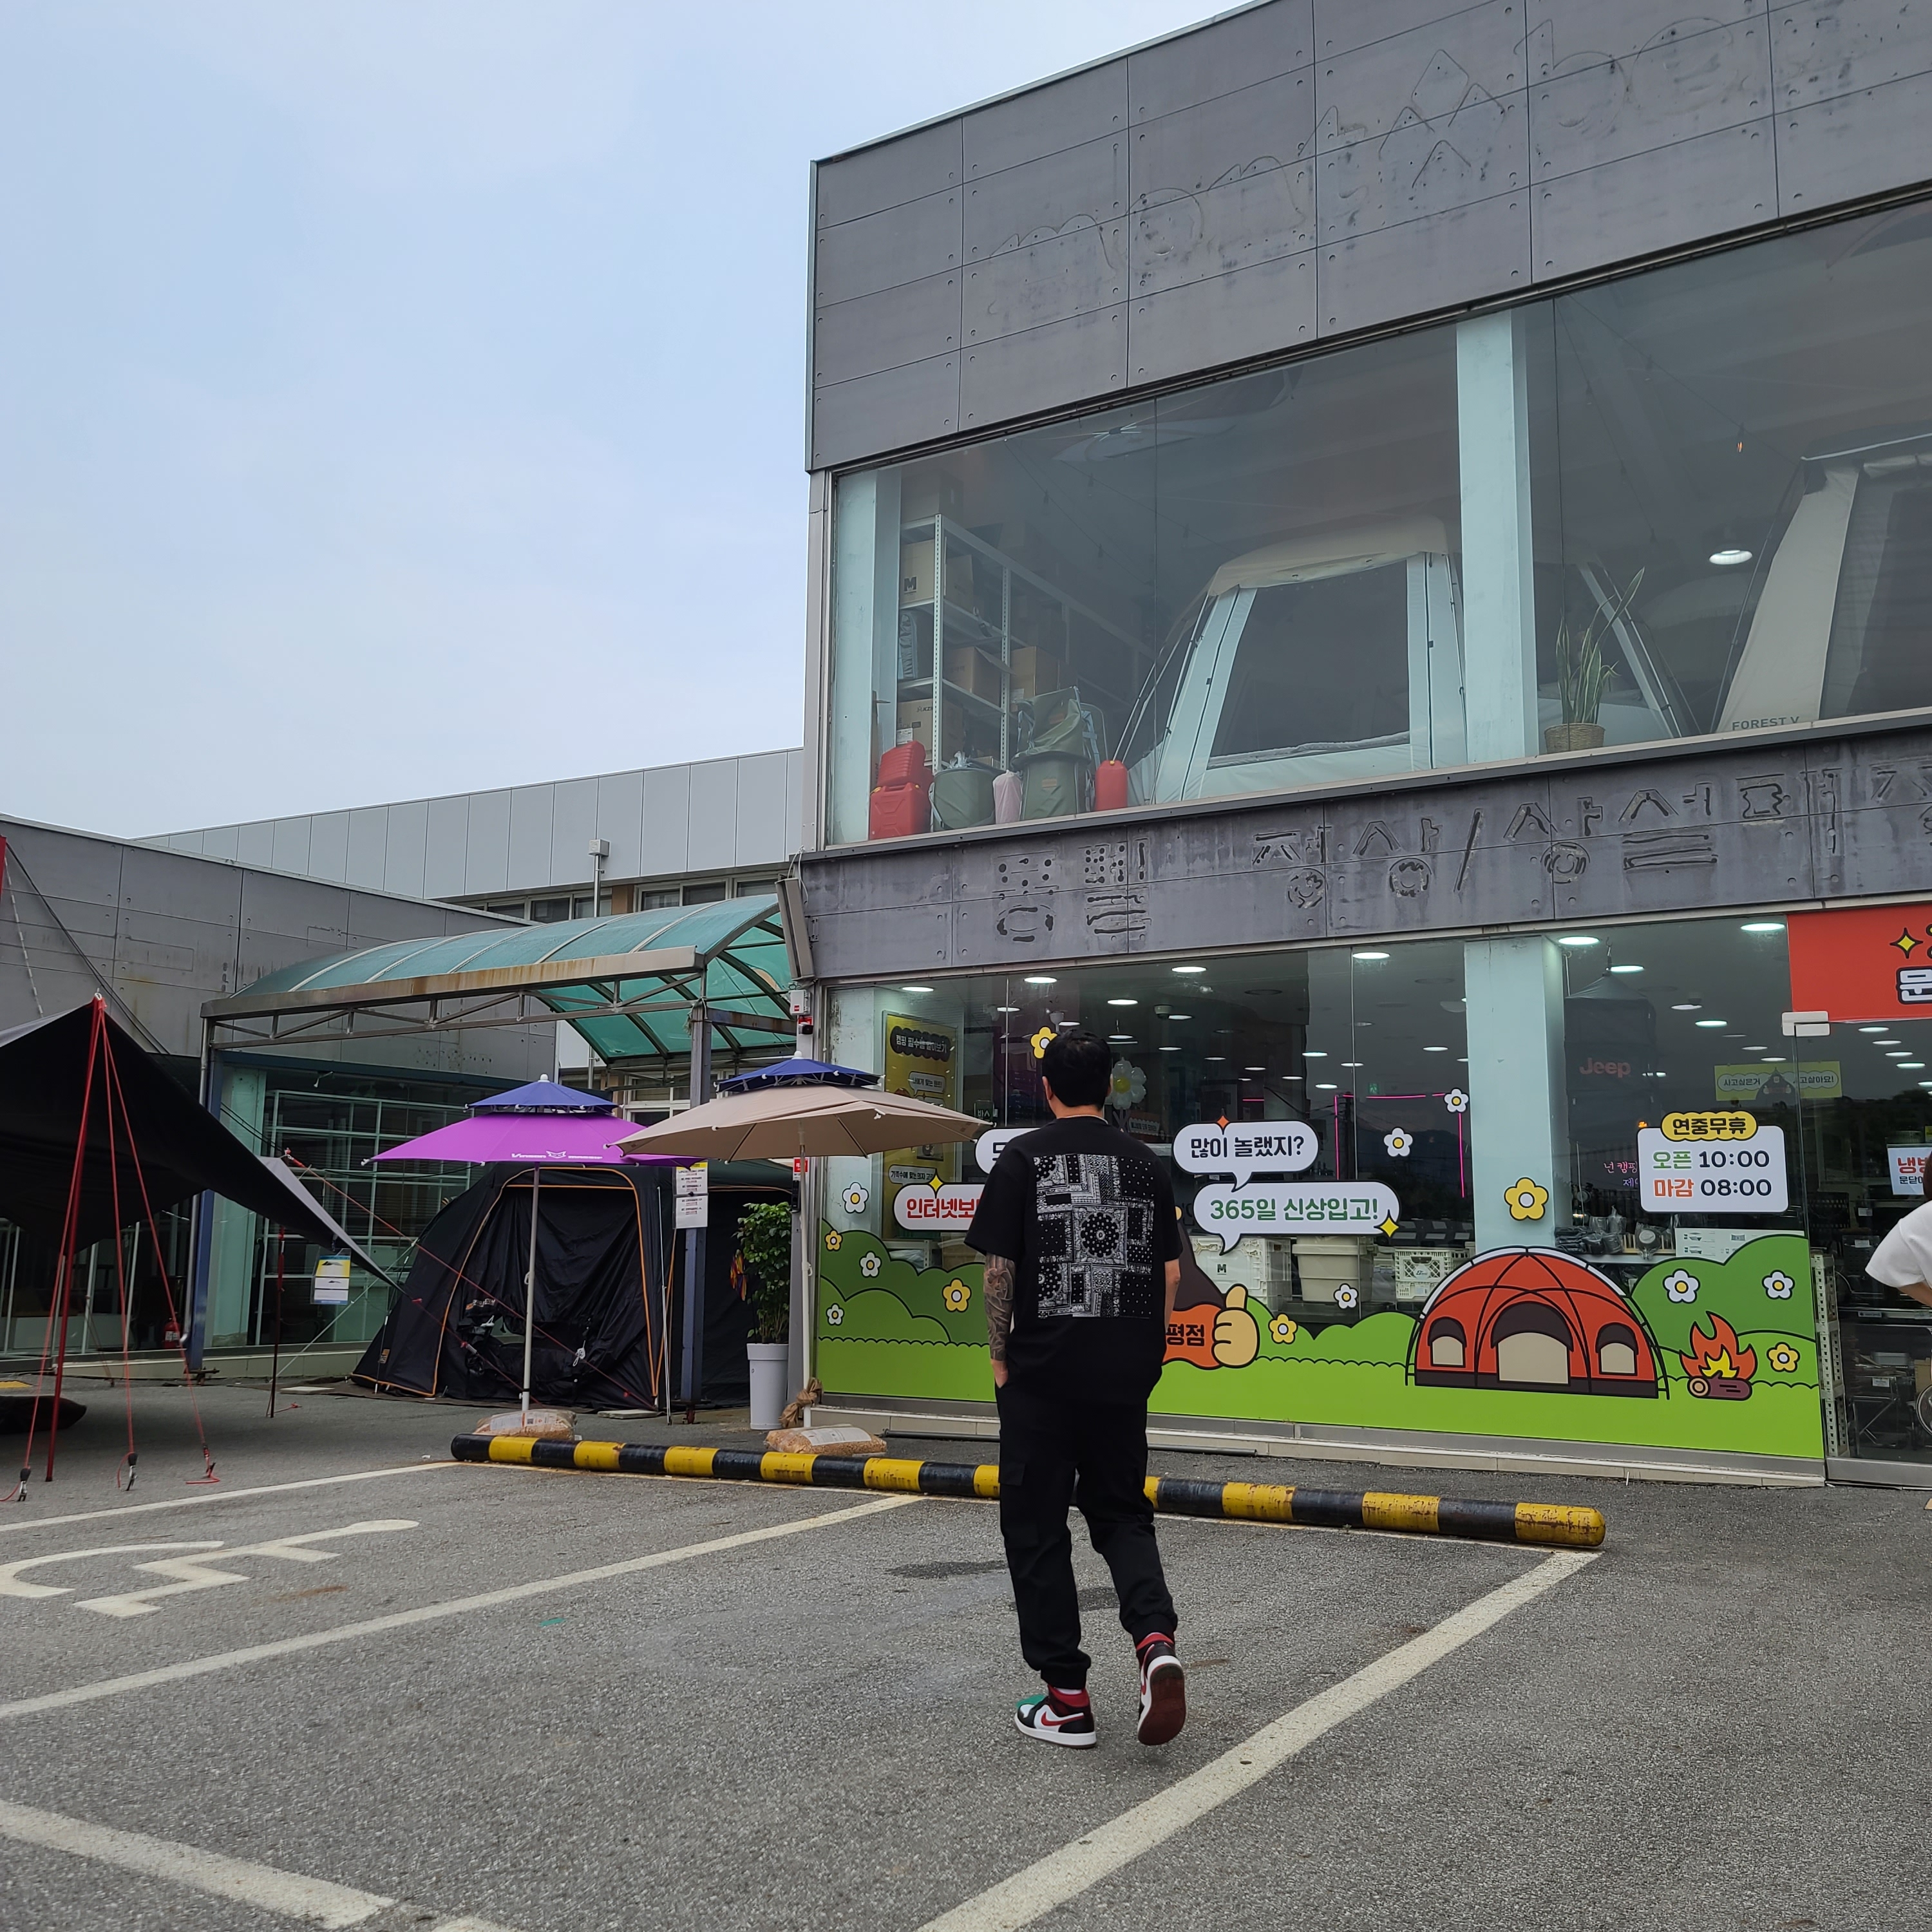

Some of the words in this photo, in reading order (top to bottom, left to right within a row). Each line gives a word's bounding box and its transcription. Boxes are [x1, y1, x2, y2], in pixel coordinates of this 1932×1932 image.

[1732, 717, 1785, 732] FOREST
[1579, 1057, 1631, 1078] Jeep
[1723, 1077, 1761, 1087] 사고싶은거
[1793, 1075, 1835, 1084] 고살아요!
[1672, 1117, 1747, 1136] 연중무휴
[1190, 1137, 1228, 1159] 많이
[1234, 1135, 1305, 1158] 놀랬지?
[1604, 1161, 1615, 1173] 넌
[1653, 1150, 1693, 1170] 오픈
[1698, 1150, 1770, 1168] 10:00
[1623, 1177, 1638, 1188] 제
[1654, 1178, 1694, 1198] 마감
[1700, 1179, 1773, 1197] 08:00
[906, 1197, 980, 1219] 인터넷보
[1209, 1198, 1277, 1222] 365일
[1283, 1197, 1379, 1222] 신상입고!
[1166, 1323, 1205, 1346] 평점
